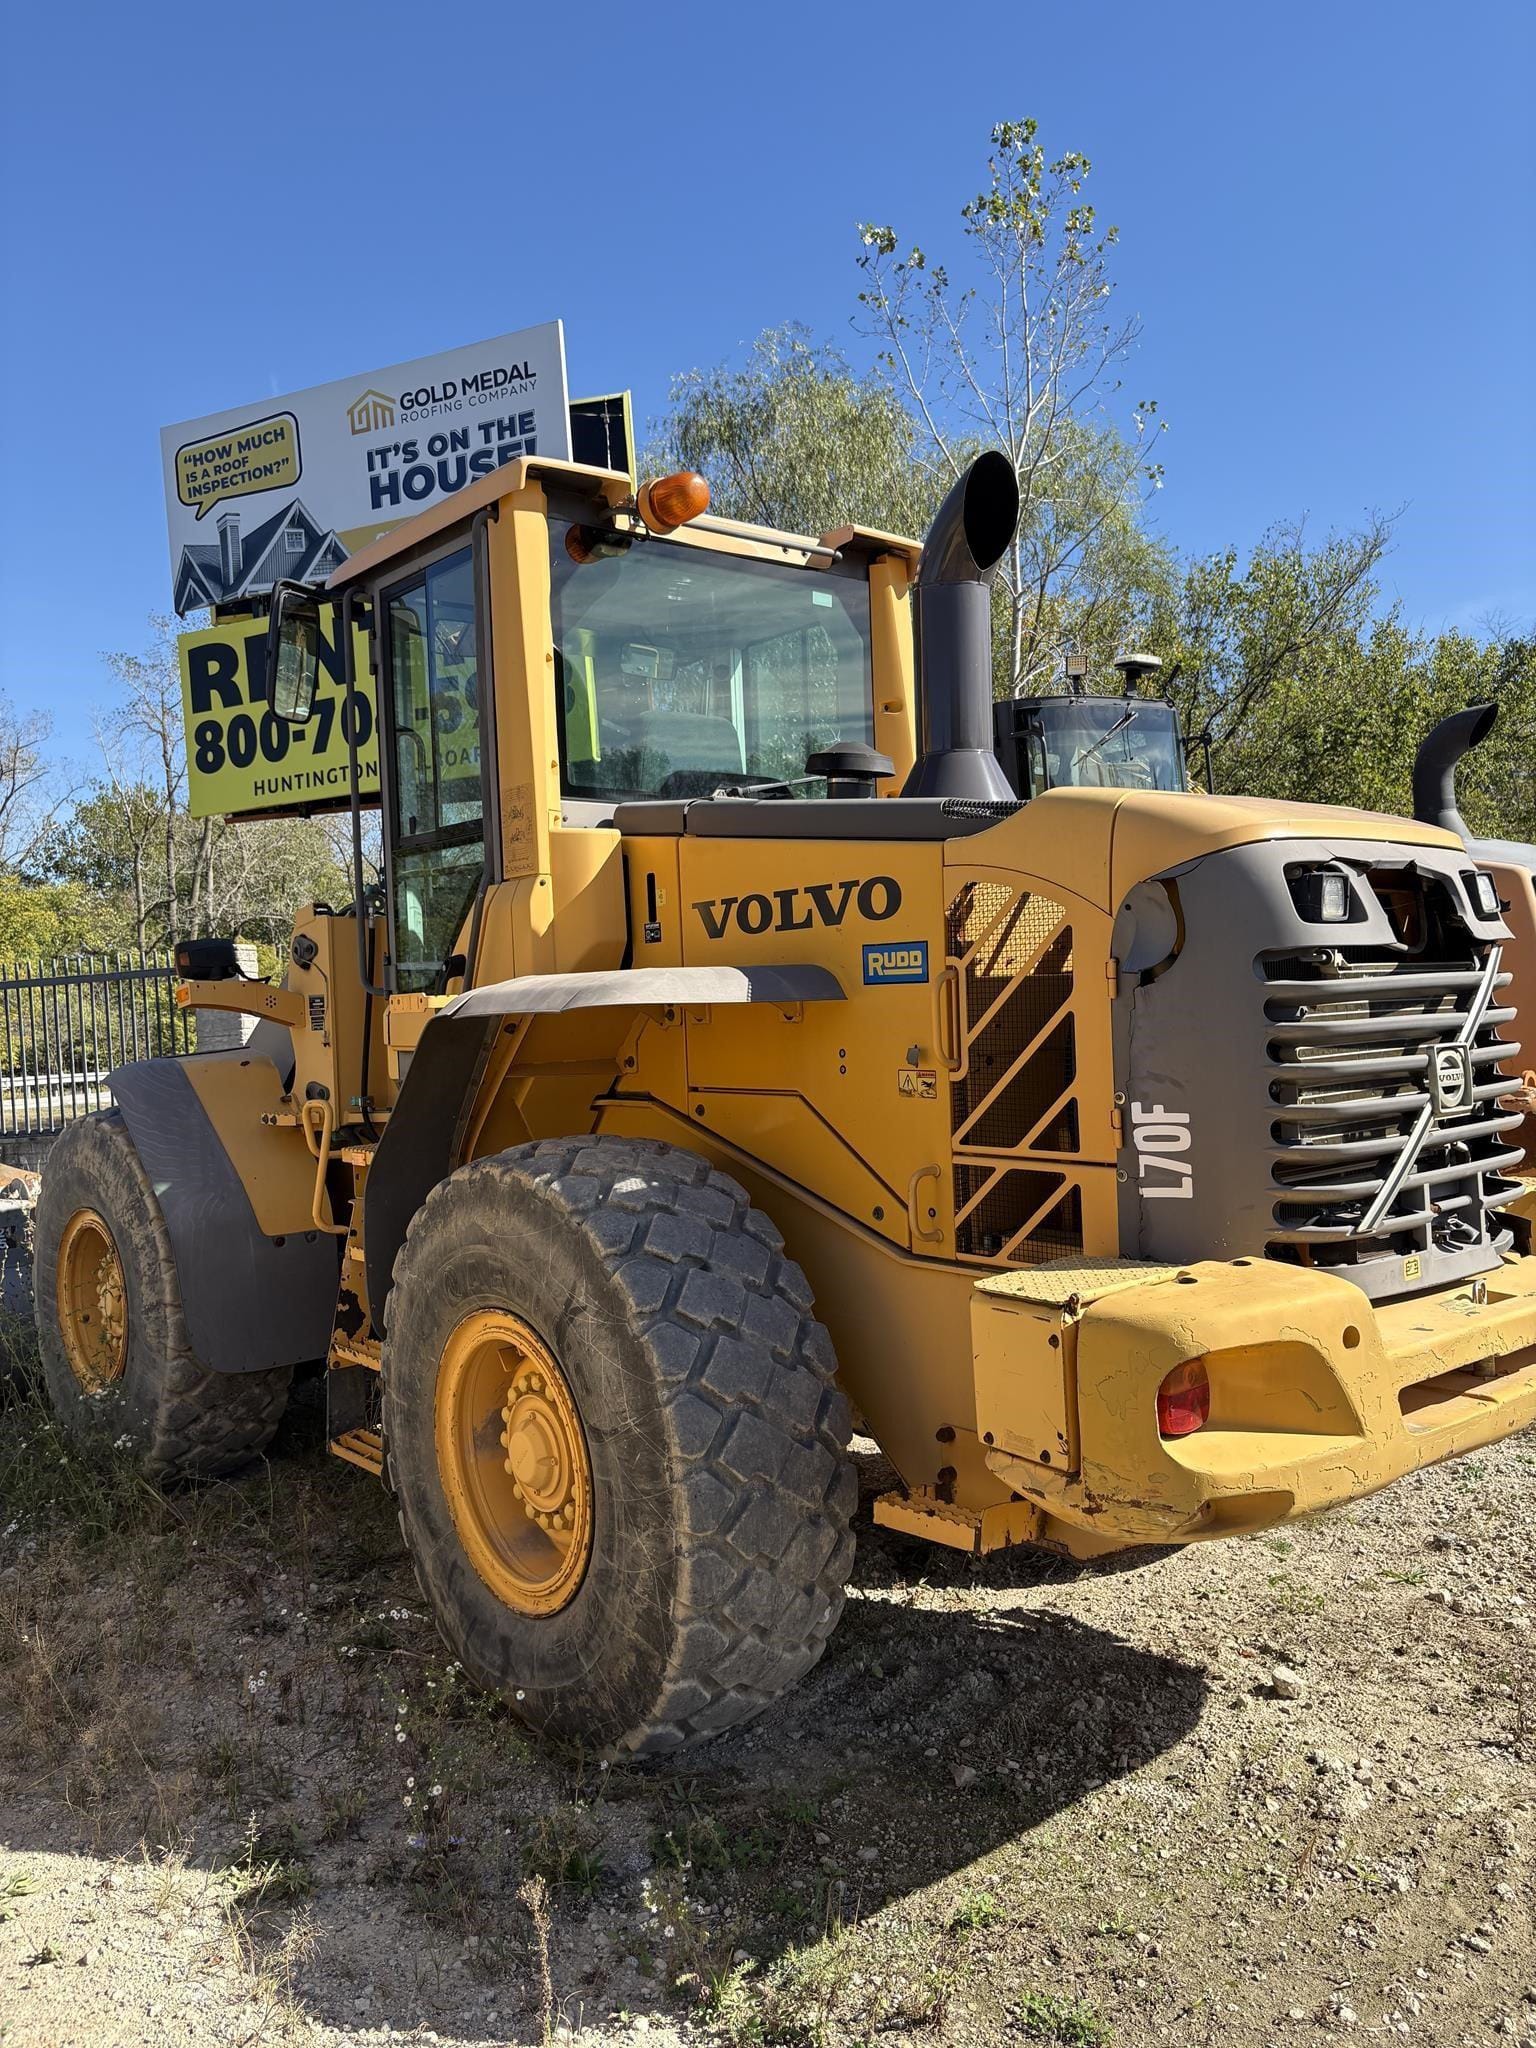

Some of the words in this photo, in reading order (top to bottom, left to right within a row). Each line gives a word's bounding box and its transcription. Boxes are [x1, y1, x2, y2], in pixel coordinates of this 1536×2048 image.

[400, 381, 458, 411] GOLD
[461, 361, 537, 396] MEDAL
[401, 402, 463, 424] ROOFING
[468, 379, 537, 407] COMPANY
[237, 427, 286, 453] MUCH
[428, 426, 469, 457] ON
[478, 409, 537, 445] THE
[185, 471, 198, 484] IS
[201, 468, 210, 479] A
[213, 456, 249, 476] ROOF
[692, 876, 902, 939] VOLVO
[868, 950, 922, 976] RUDD
[1131, 1102, 1193, 1199] L70F
